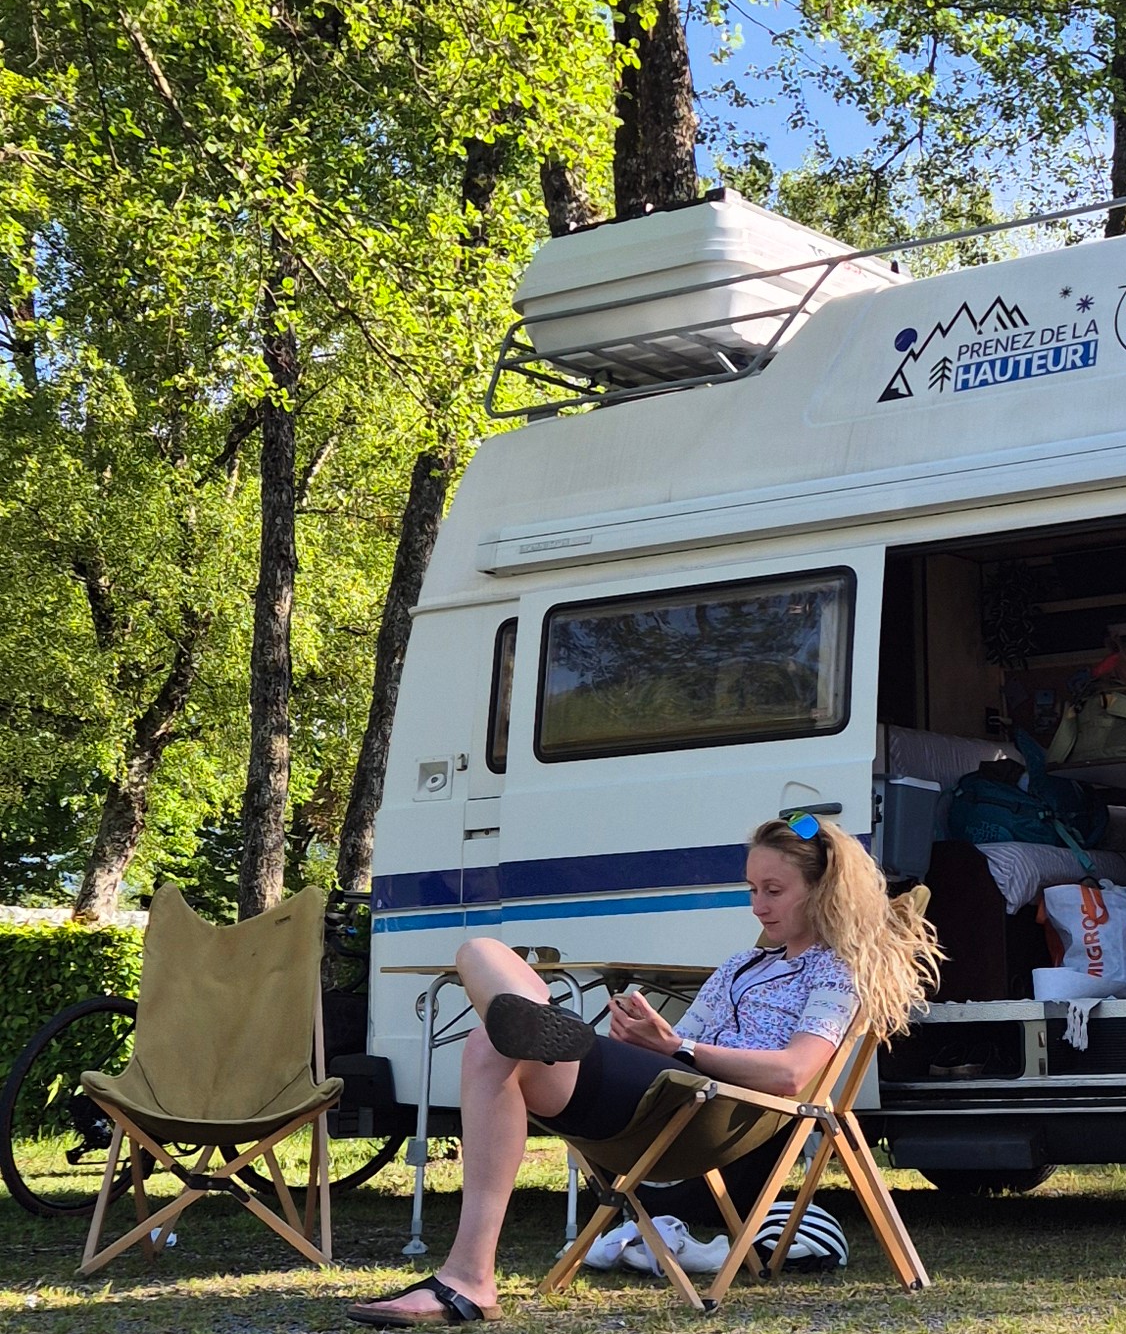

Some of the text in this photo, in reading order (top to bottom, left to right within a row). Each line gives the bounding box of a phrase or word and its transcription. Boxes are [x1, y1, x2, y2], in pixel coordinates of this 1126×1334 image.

[957, 319, 1099, 362] PRENEZ DE LA
